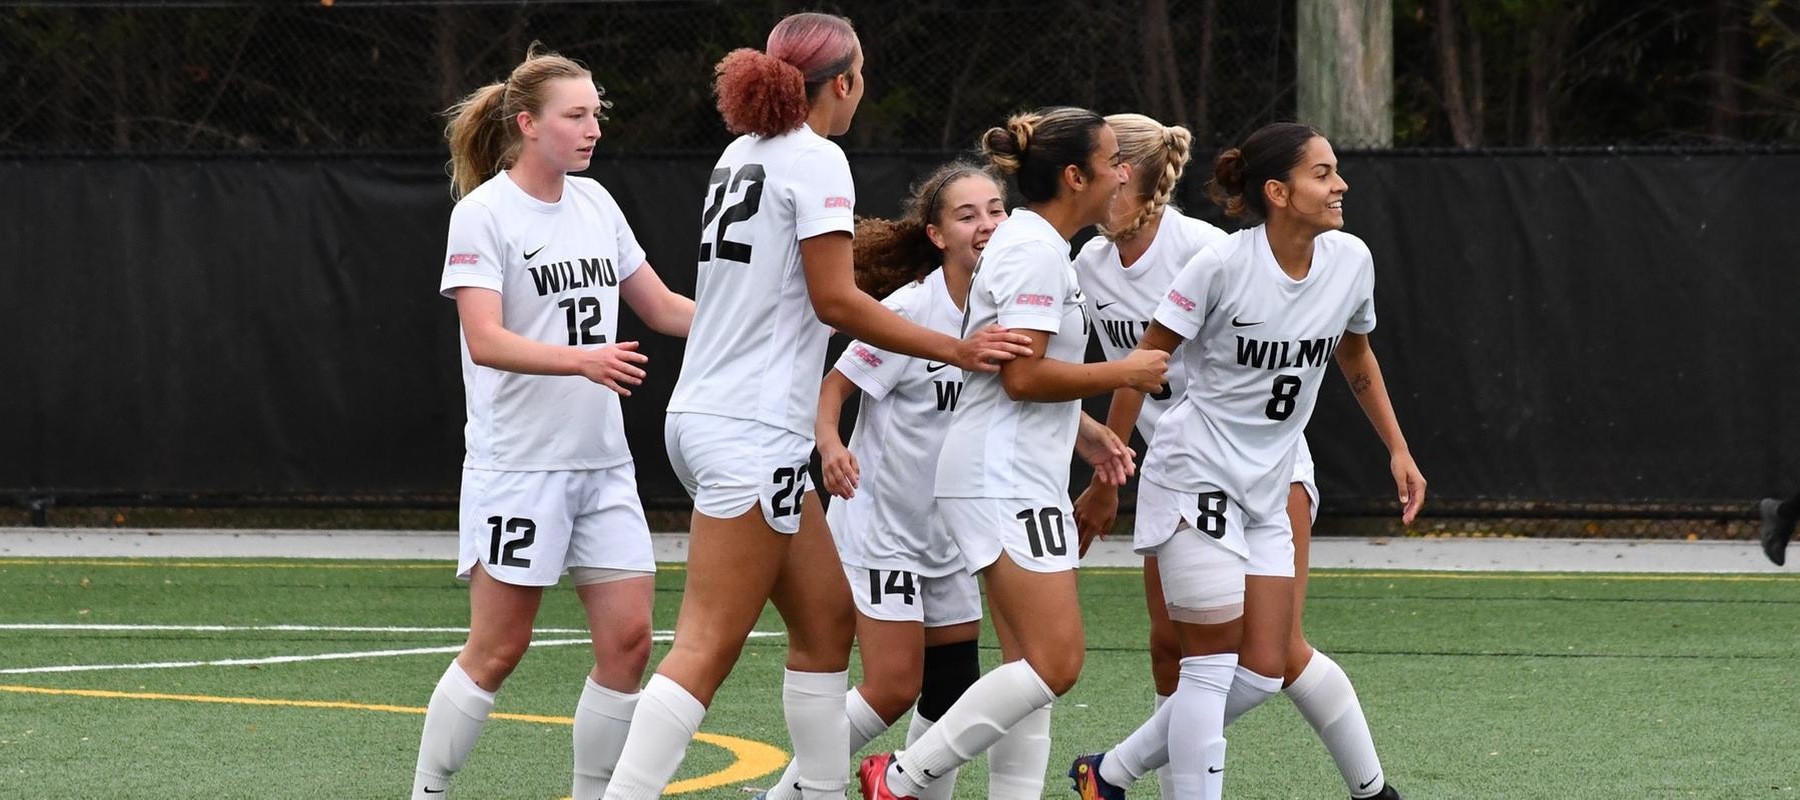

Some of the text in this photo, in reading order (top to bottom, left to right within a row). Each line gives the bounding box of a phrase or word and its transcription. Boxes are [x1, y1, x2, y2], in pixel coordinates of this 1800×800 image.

[698, 163, 766, 264] 22
[528, 258, 618, 296] WILMU
[558, 297, 606, 346] 12
[1100, 319, 1149, 349] WIL
[1265, 374, 1302, 421] 8
[1016, 506, 1068, 558] 10
[1197, 490, 1228, 540] 8
[487, 515, 537, 569] 12
[869, 569, 915, 605] 14
